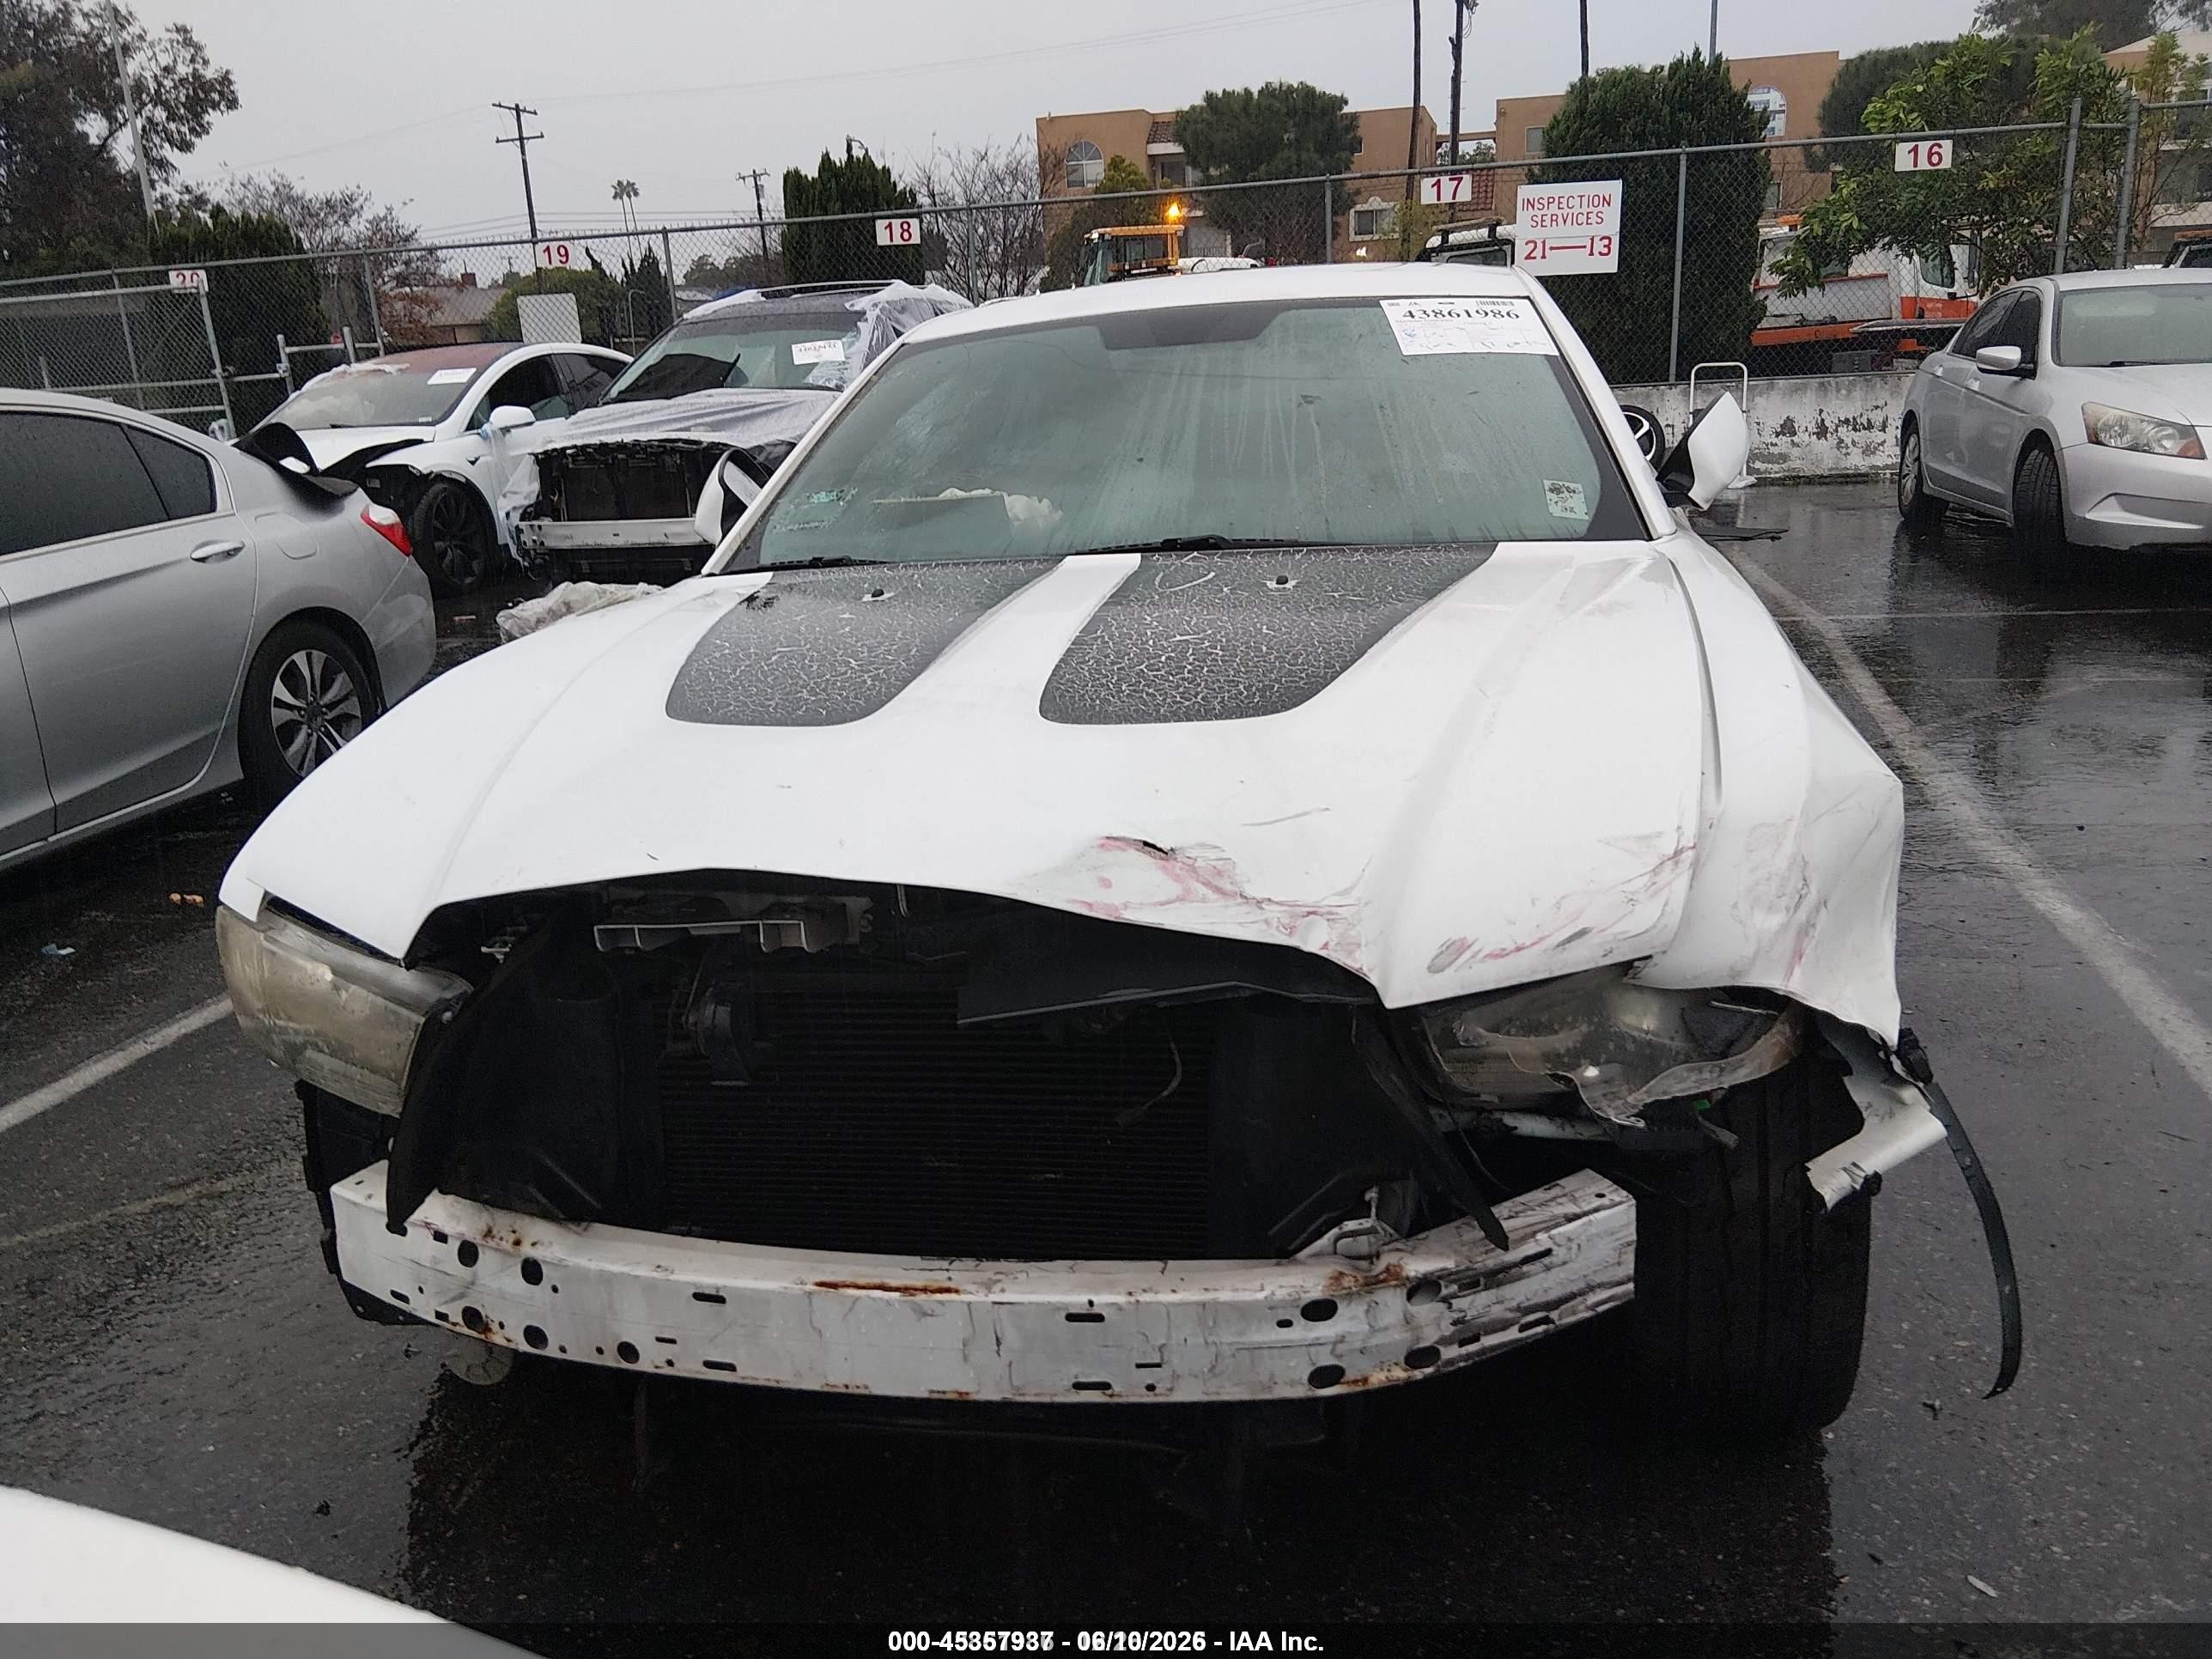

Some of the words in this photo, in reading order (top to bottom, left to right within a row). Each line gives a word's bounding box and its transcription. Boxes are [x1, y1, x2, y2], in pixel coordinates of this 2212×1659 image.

[1907, 143, 1943, 168] 16
[1431, 176, 1464, 202] 17
[1521, 193, 1612, 212] INSPECTION
[1529, 210, 1605, 228] SERVICES
[884, 220, 913, 243] 18
[542, 244, 569, 265] 19
[1401, 307, 1521, 321] 43861986
